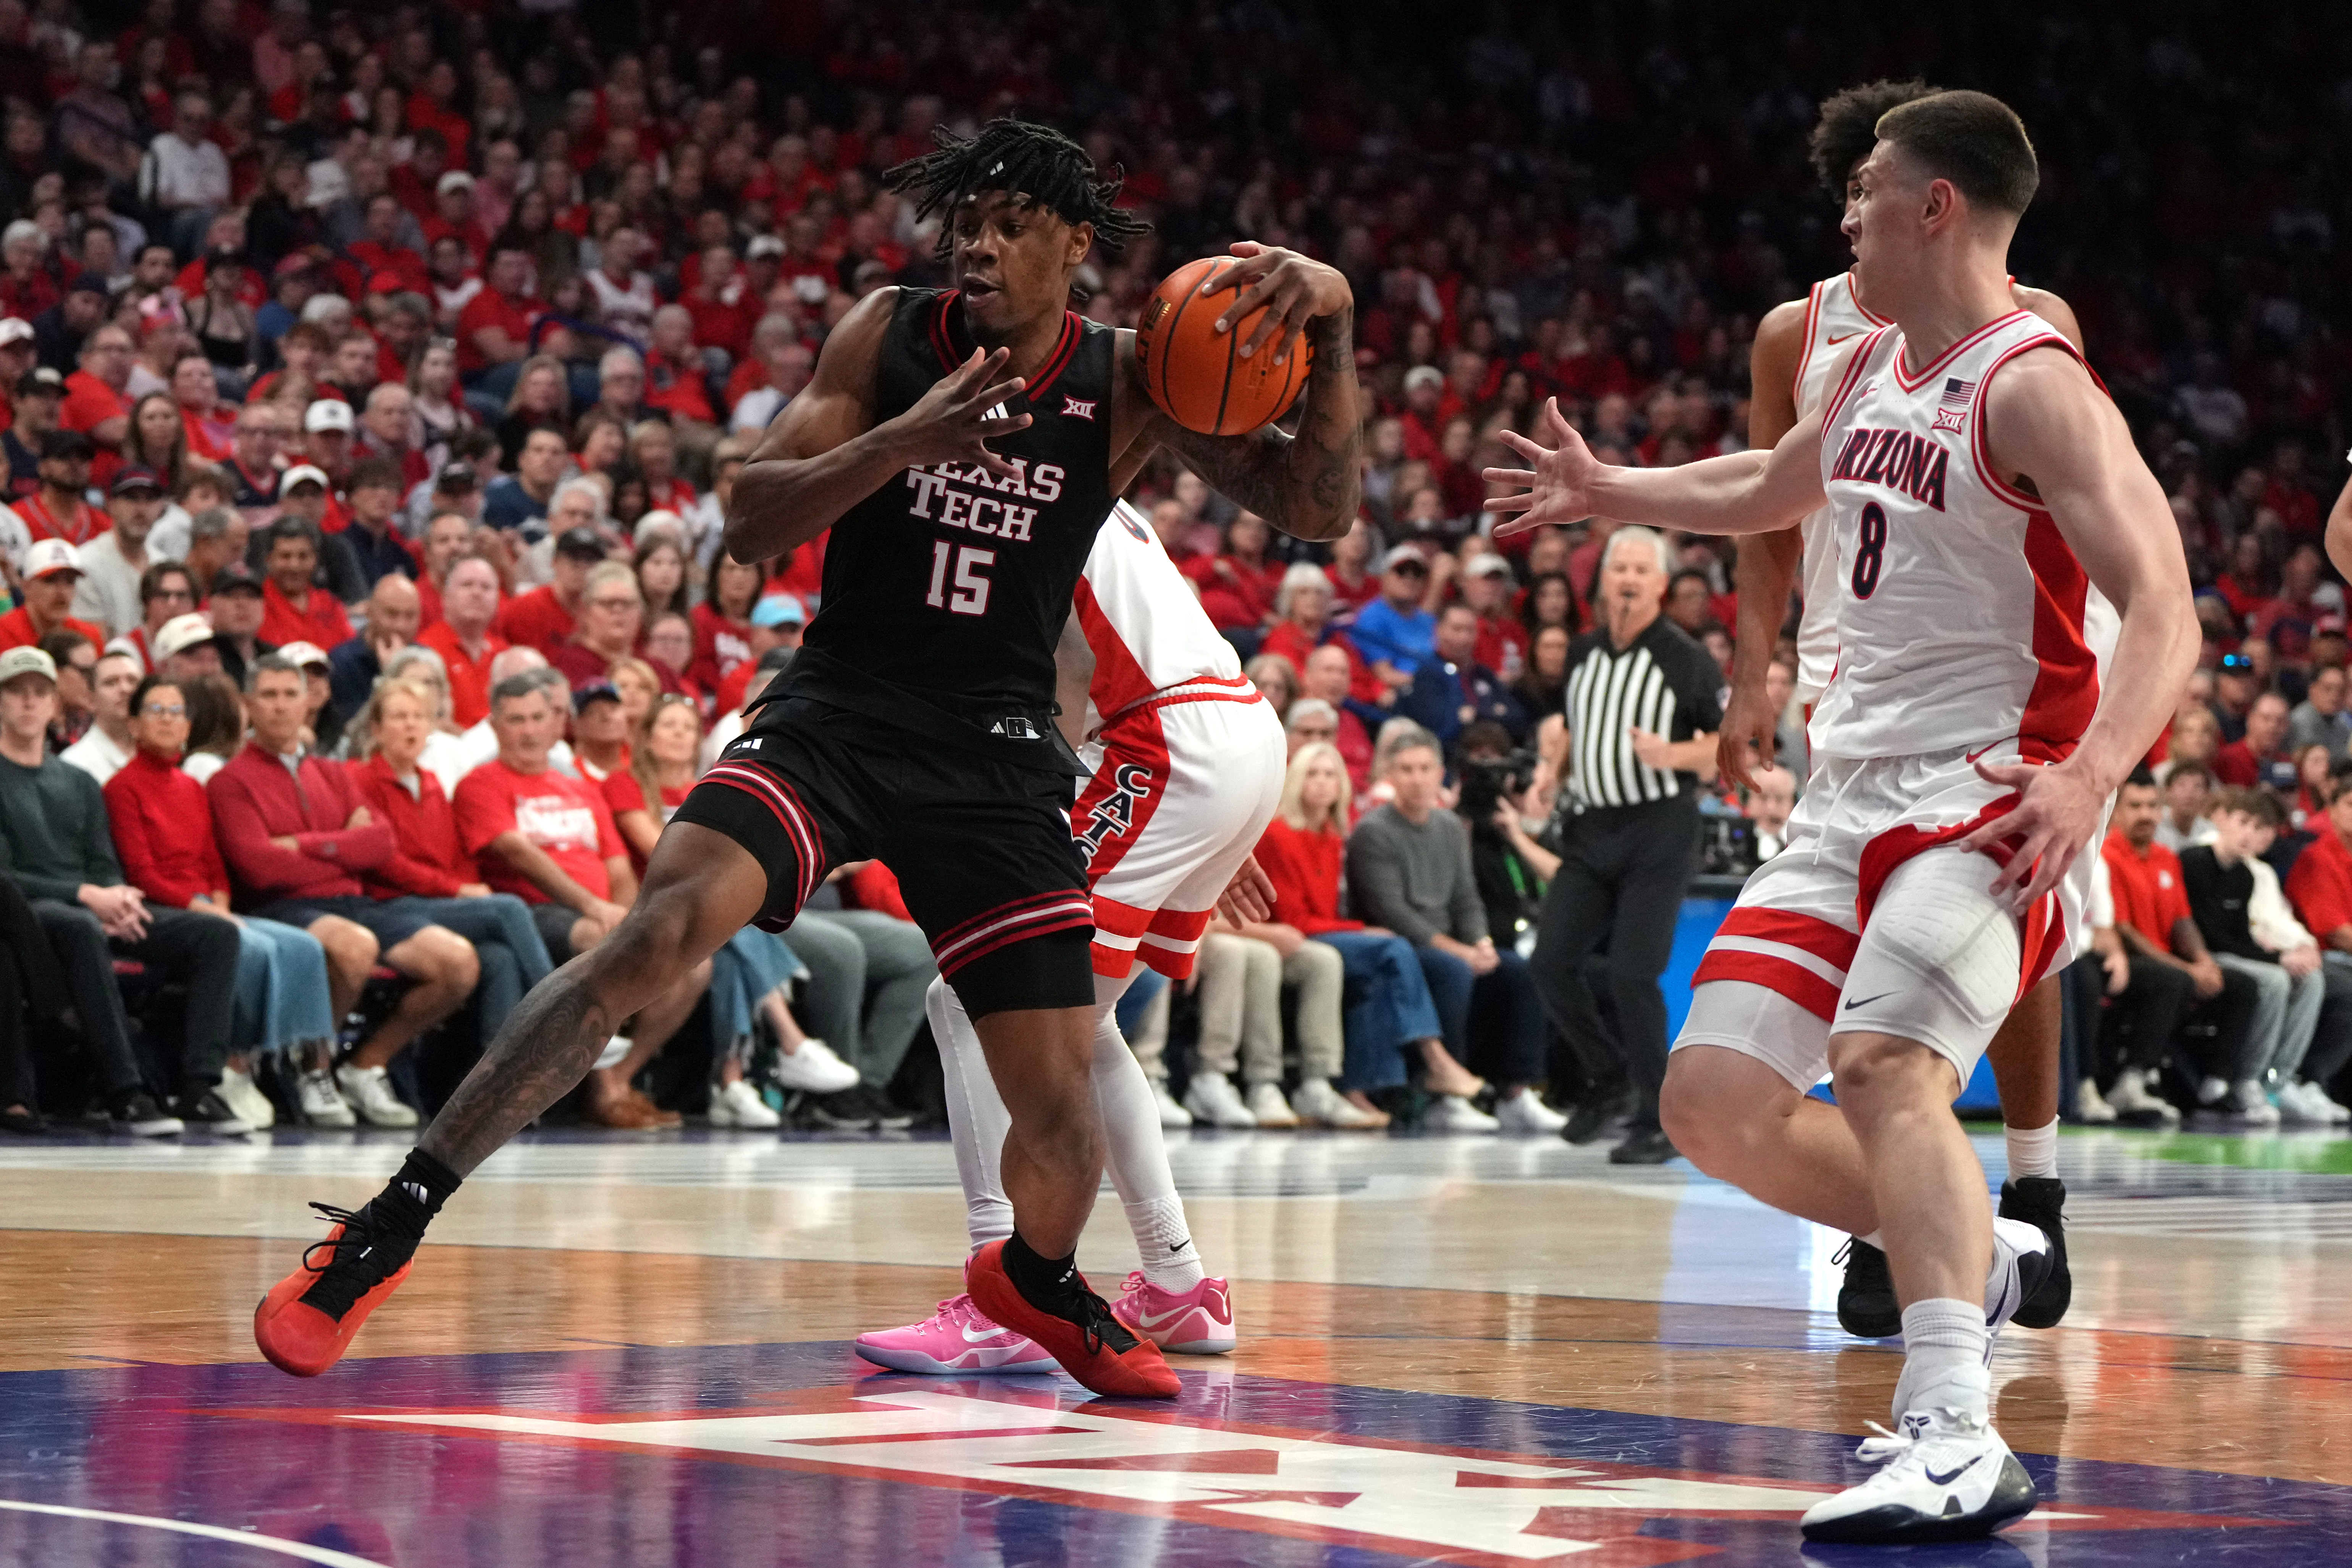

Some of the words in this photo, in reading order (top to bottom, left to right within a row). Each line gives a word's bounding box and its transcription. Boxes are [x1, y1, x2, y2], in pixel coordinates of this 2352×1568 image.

[906, 468, 1039, 542] TECH
[908, 451, 1066, 502] EXAS
[926, 538, 997, 617] 15
[1851, 501, 1887, 600] 8
